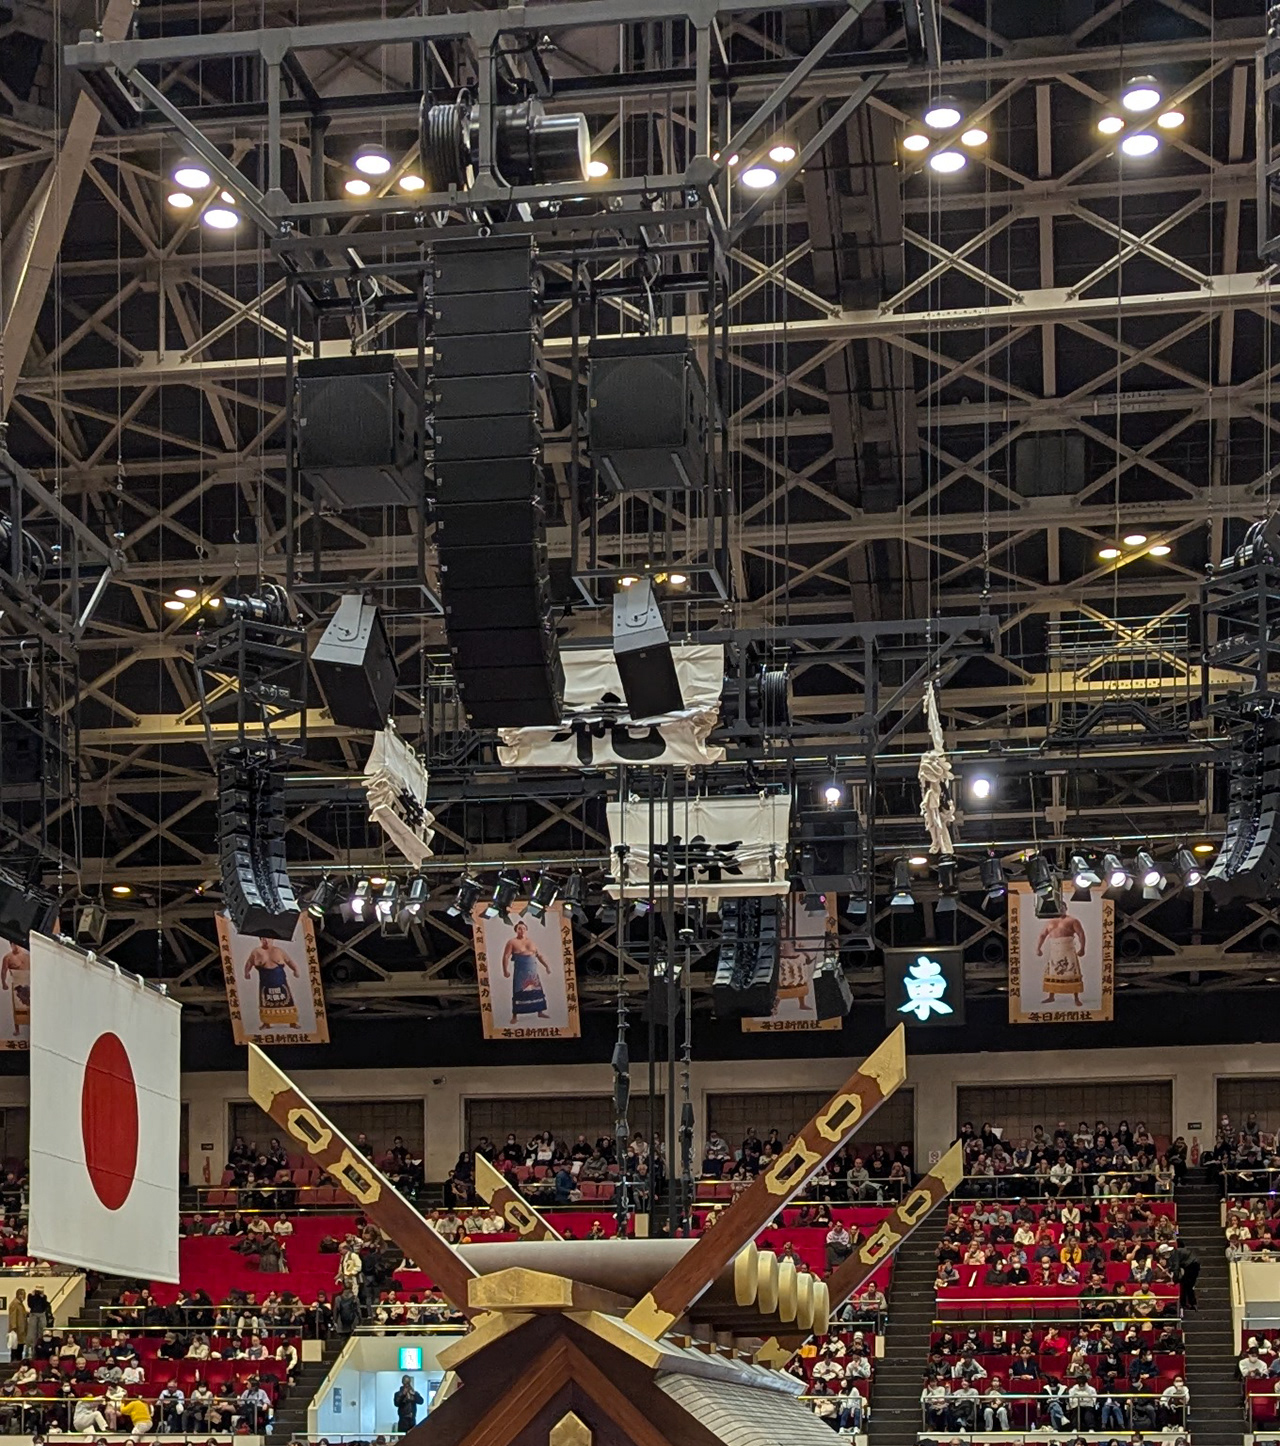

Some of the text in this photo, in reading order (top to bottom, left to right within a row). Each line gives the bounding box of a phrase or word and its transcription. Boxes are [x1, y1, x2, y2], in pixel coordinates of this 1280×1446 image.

[560, 925, 578, 1013] 令和五年十一月場所
[1102, 906, 1115, 996] 令和六年三月場所
[304, 933, 325, 1019] 令和五年九月場所
[896, 955, 954, 1021] 東
[501, 1027, 562, 1038] 毎日新聞社
[760, 1020, 822, 1030] 毎日新聞社
[1027, 1011, 1093, 1022] 毎日新聞社
[252, 1033, 311, 1043] 毎日新聞社
